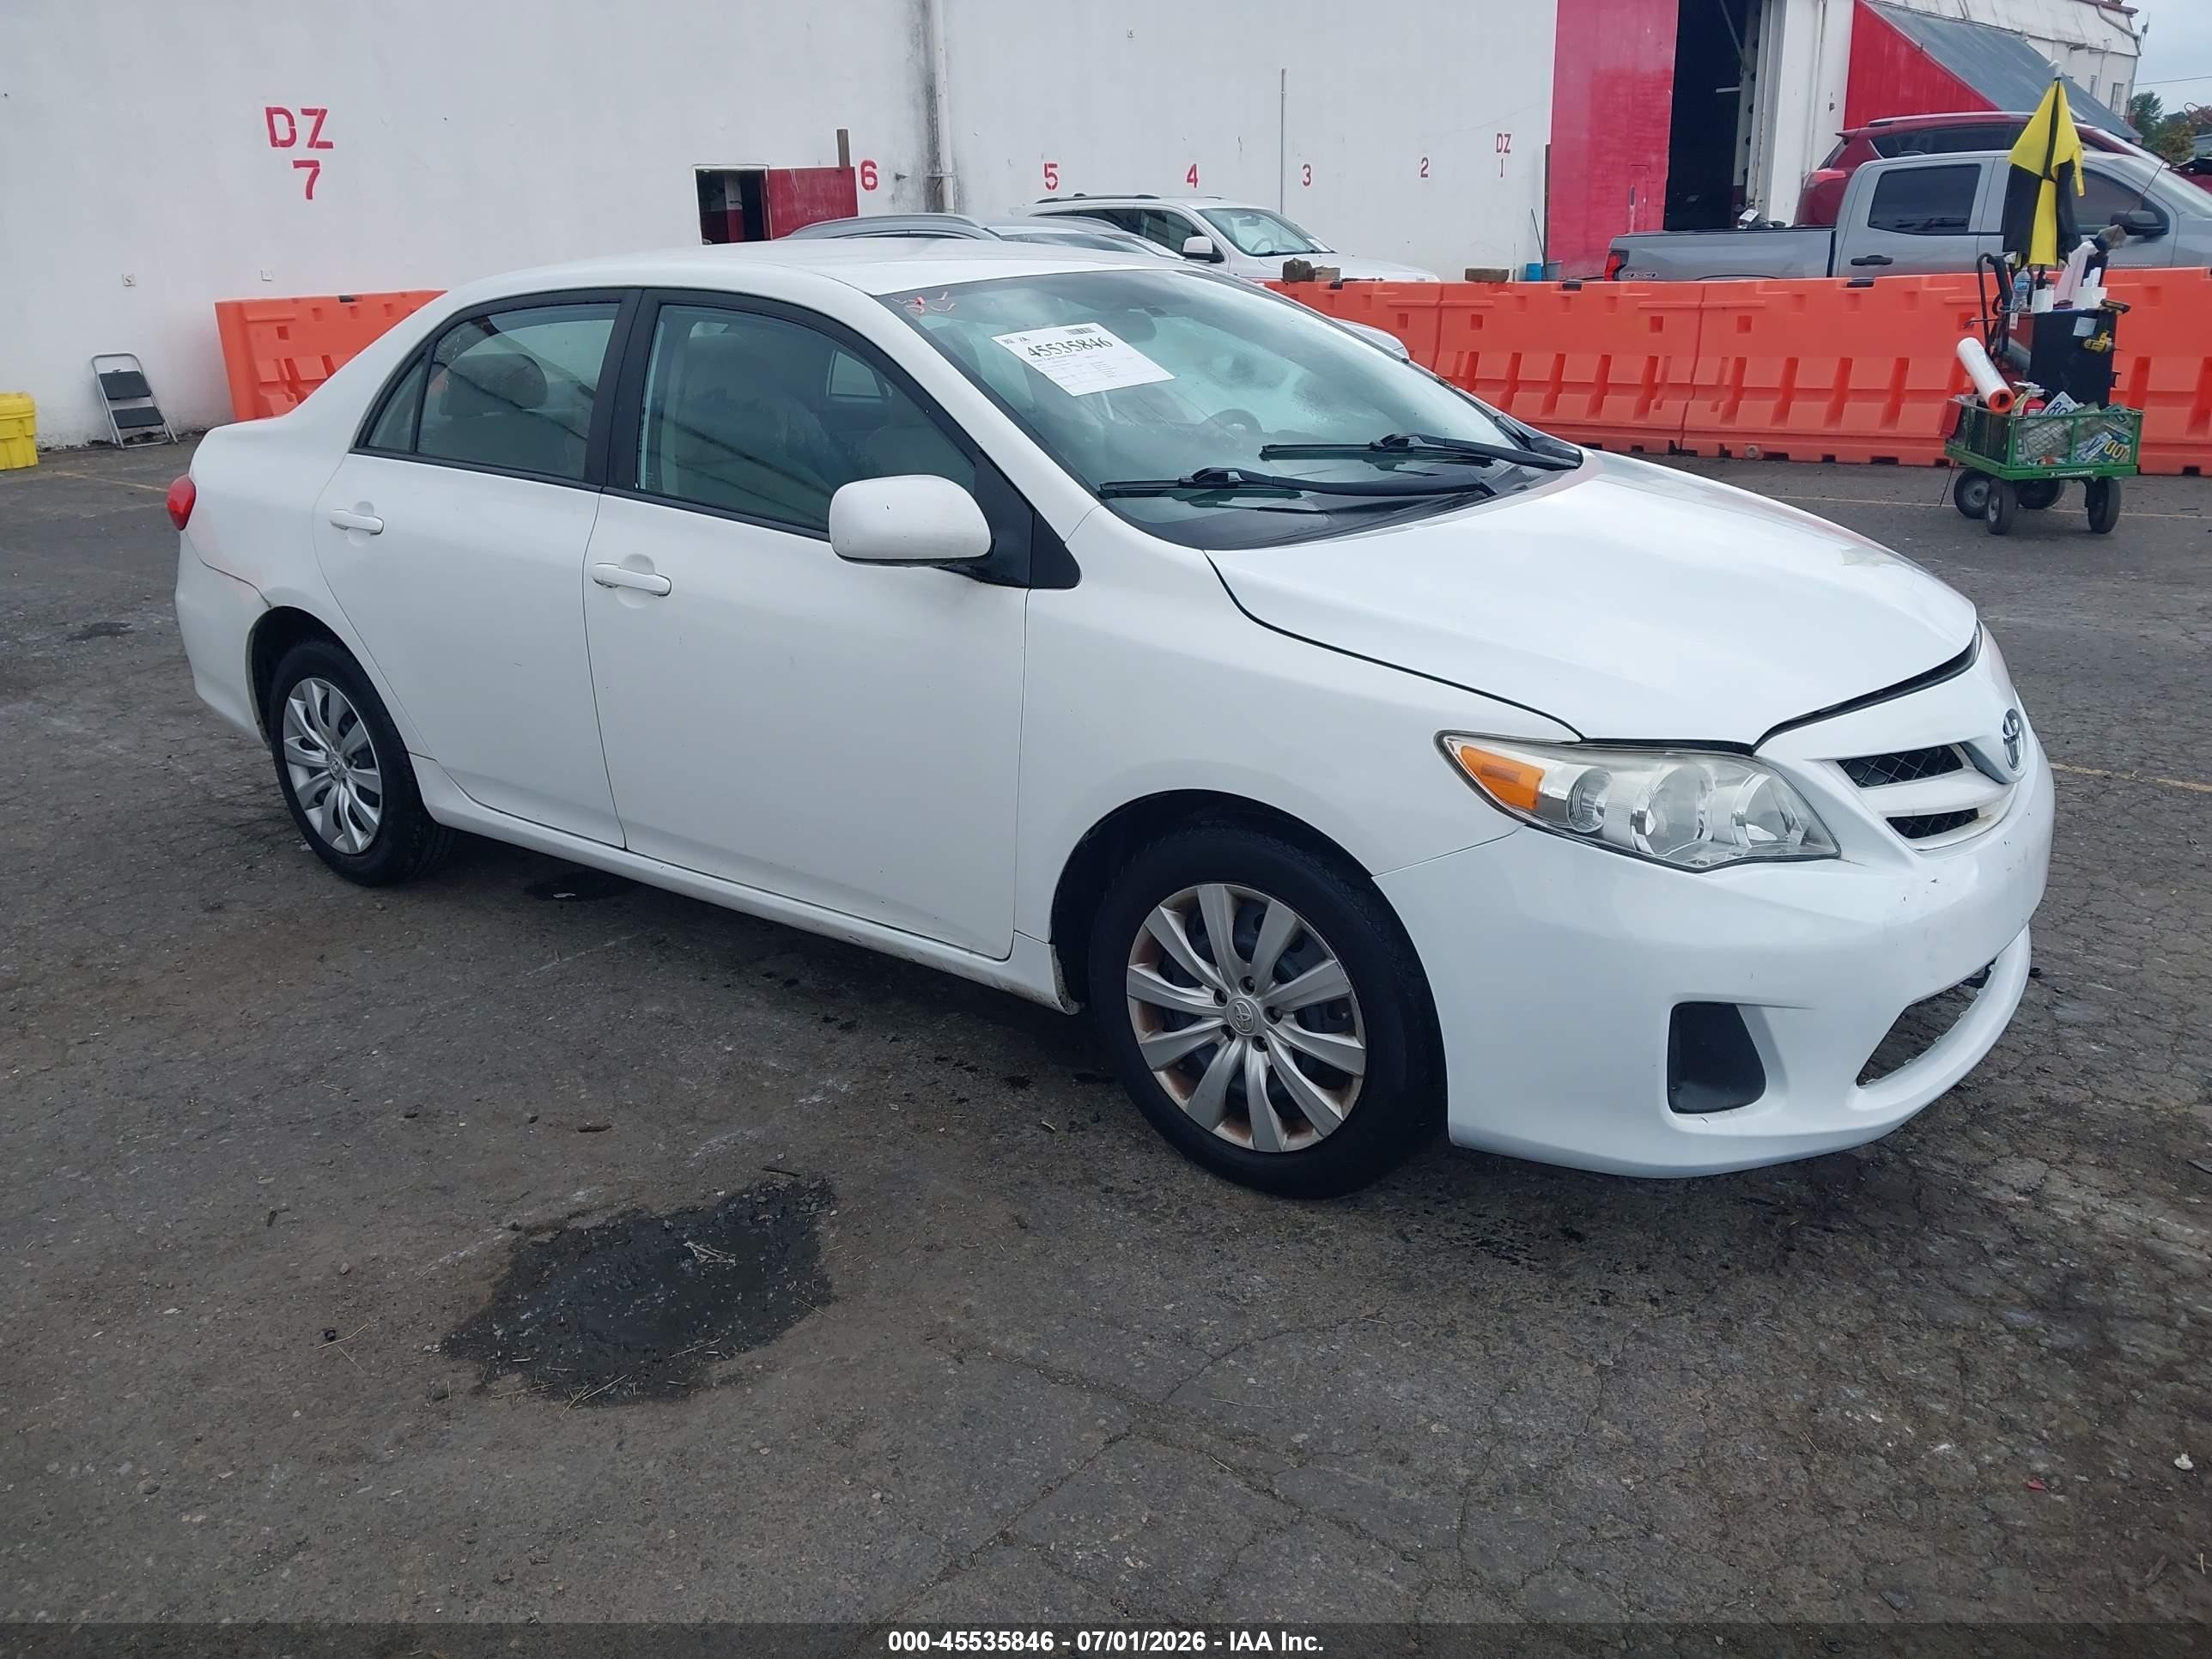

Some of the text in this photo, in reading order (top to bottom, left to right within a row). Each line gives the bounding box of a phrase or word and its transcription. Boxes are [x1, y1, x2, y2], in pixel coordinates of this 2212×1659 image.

[264, 106, 334, 150] DZ
[1496, 133, 1512, 154] DZ
[292, 159, 321, 201] 7
[860, 159, 878, 191] 6
[1043, 162, 1059, 191] 5
[1186, 163, 1199, 189] 4
[1302, 163, 1312, 186] 3
[1419, 156, 1429, 178] 2
[1026, 336, 1114, 358] 45535846
